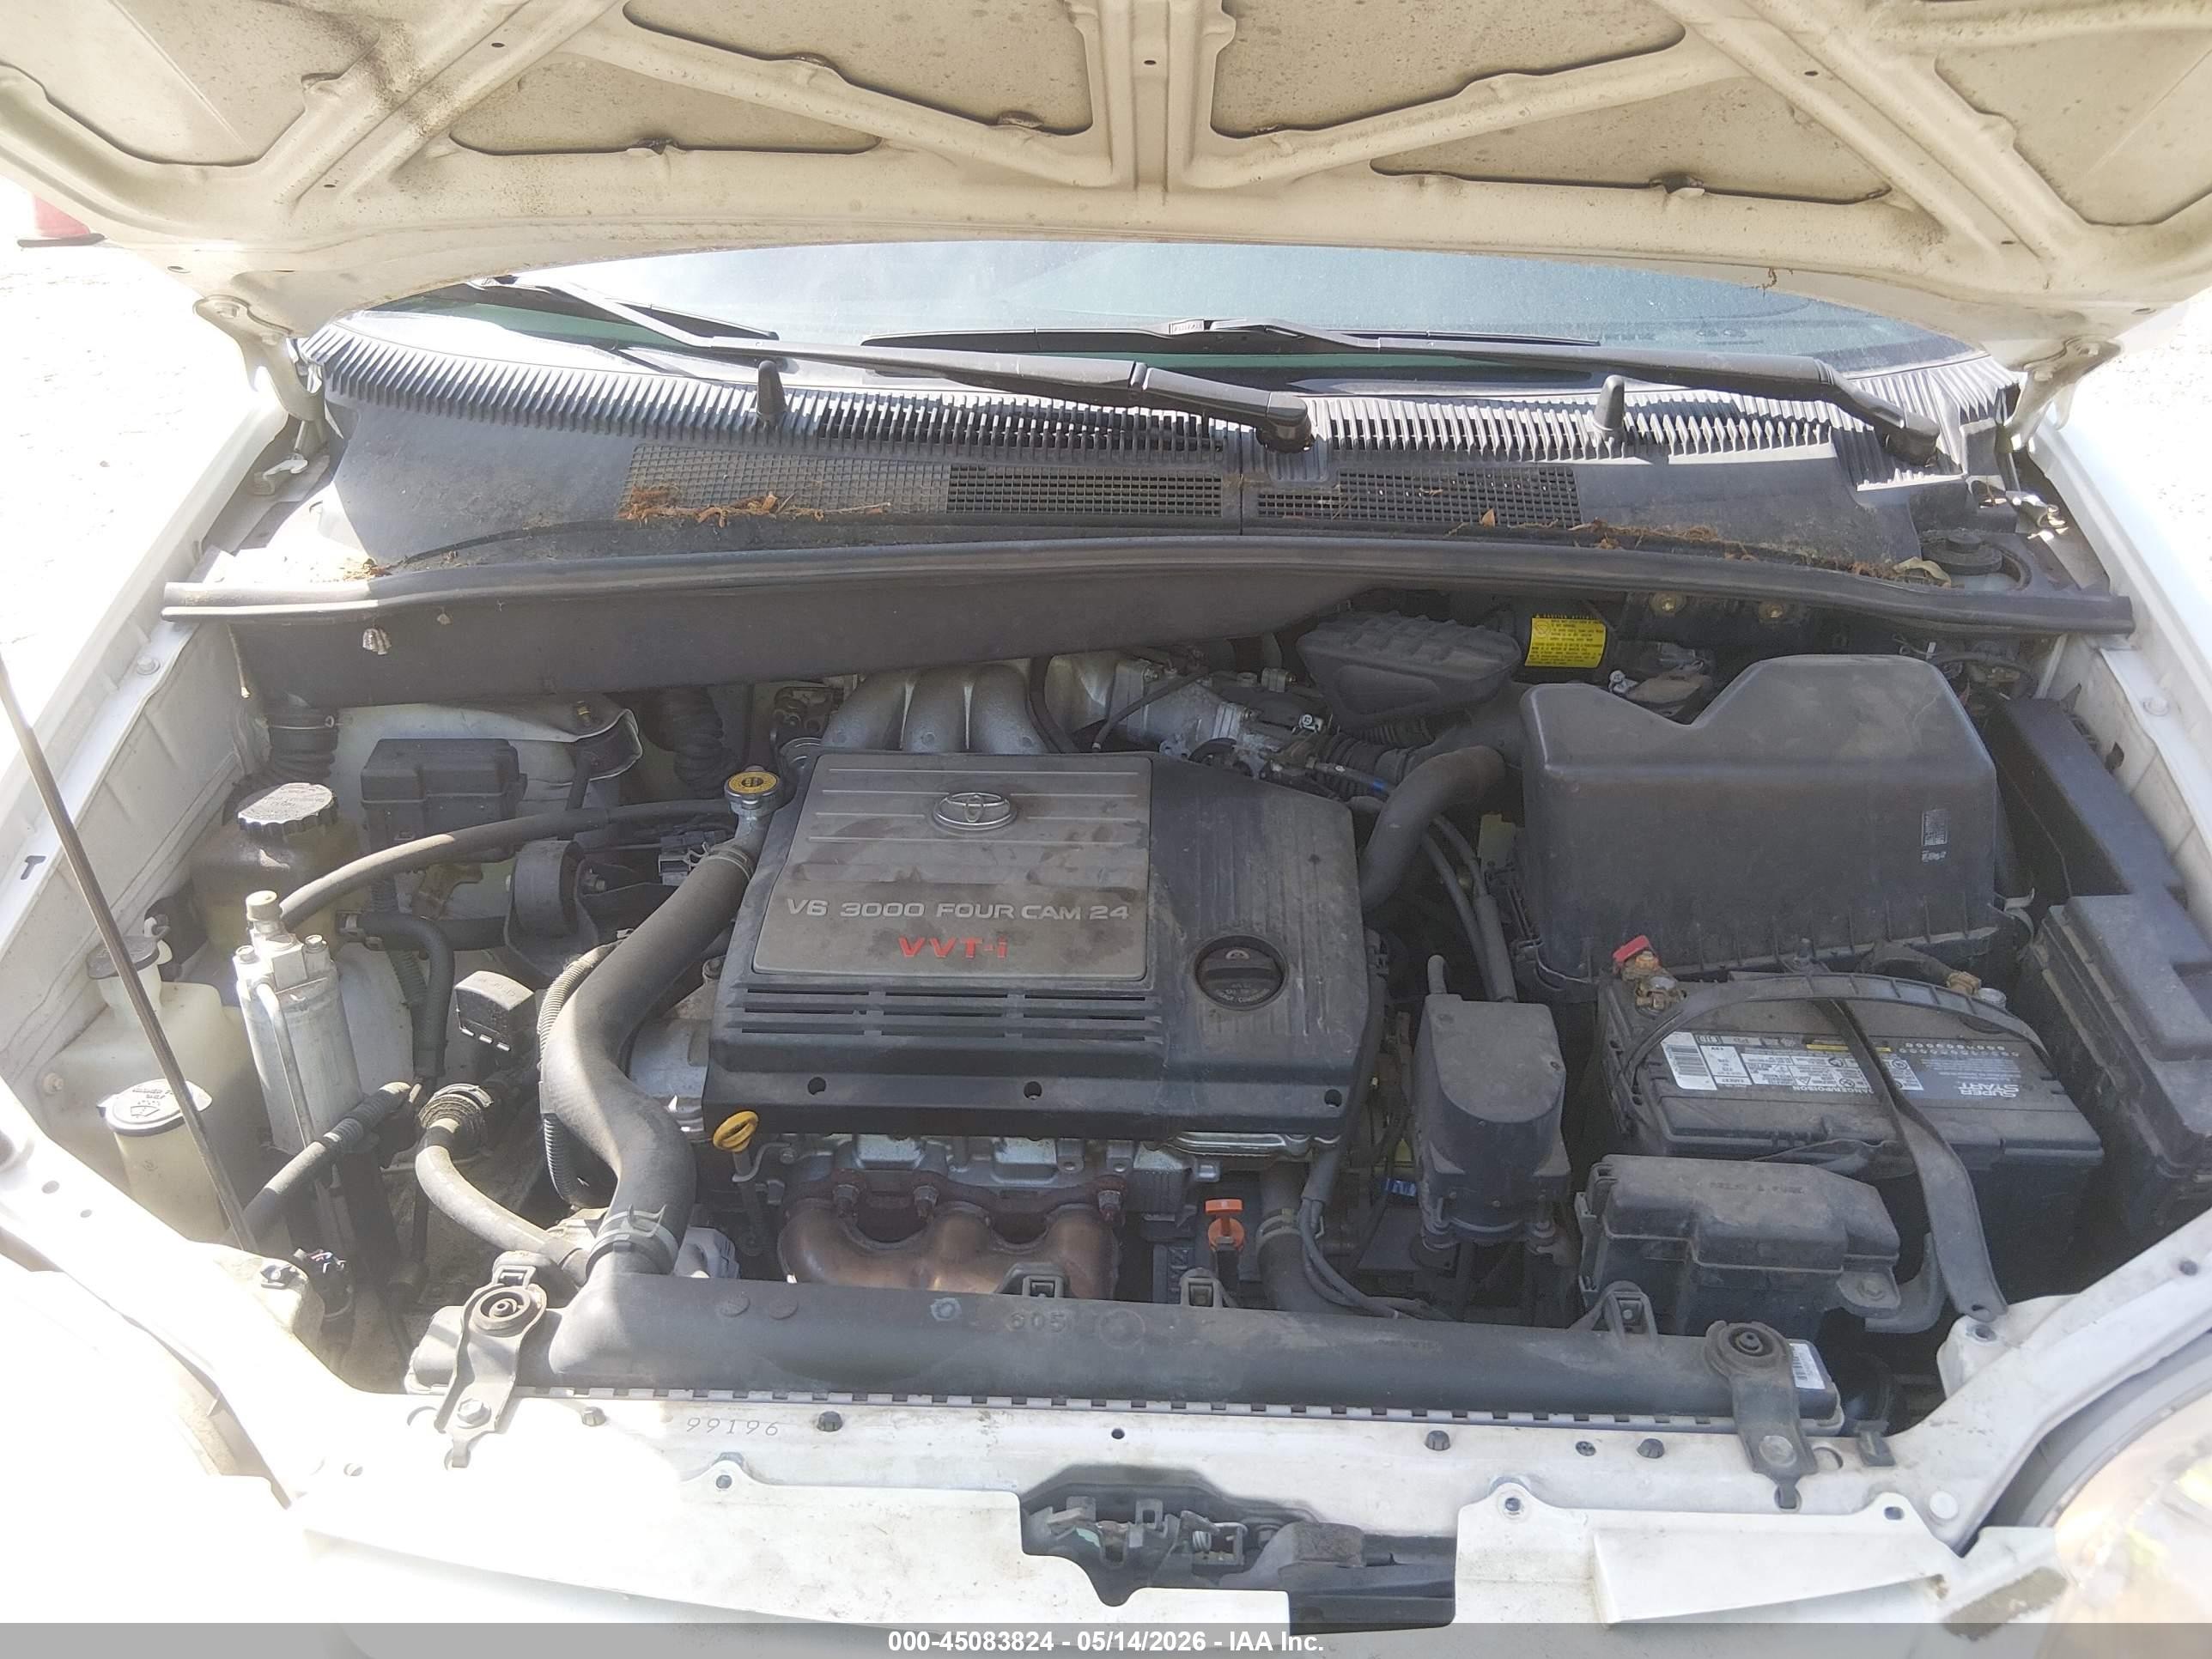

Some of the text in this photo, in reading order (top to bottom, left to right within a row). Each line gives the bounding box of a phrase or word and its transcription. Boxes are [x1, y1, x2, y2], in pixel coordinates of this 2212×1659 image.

[787, 898, 1129, 921] V6 3000 FOUR CAM 24
[898, 935, 1008, 959] VVT-i
[1958, 1082, 2020, 1092] START
[1960, 1089, 2017, 1097] SUPER
[687, 1417, 778, 1436] 99196
